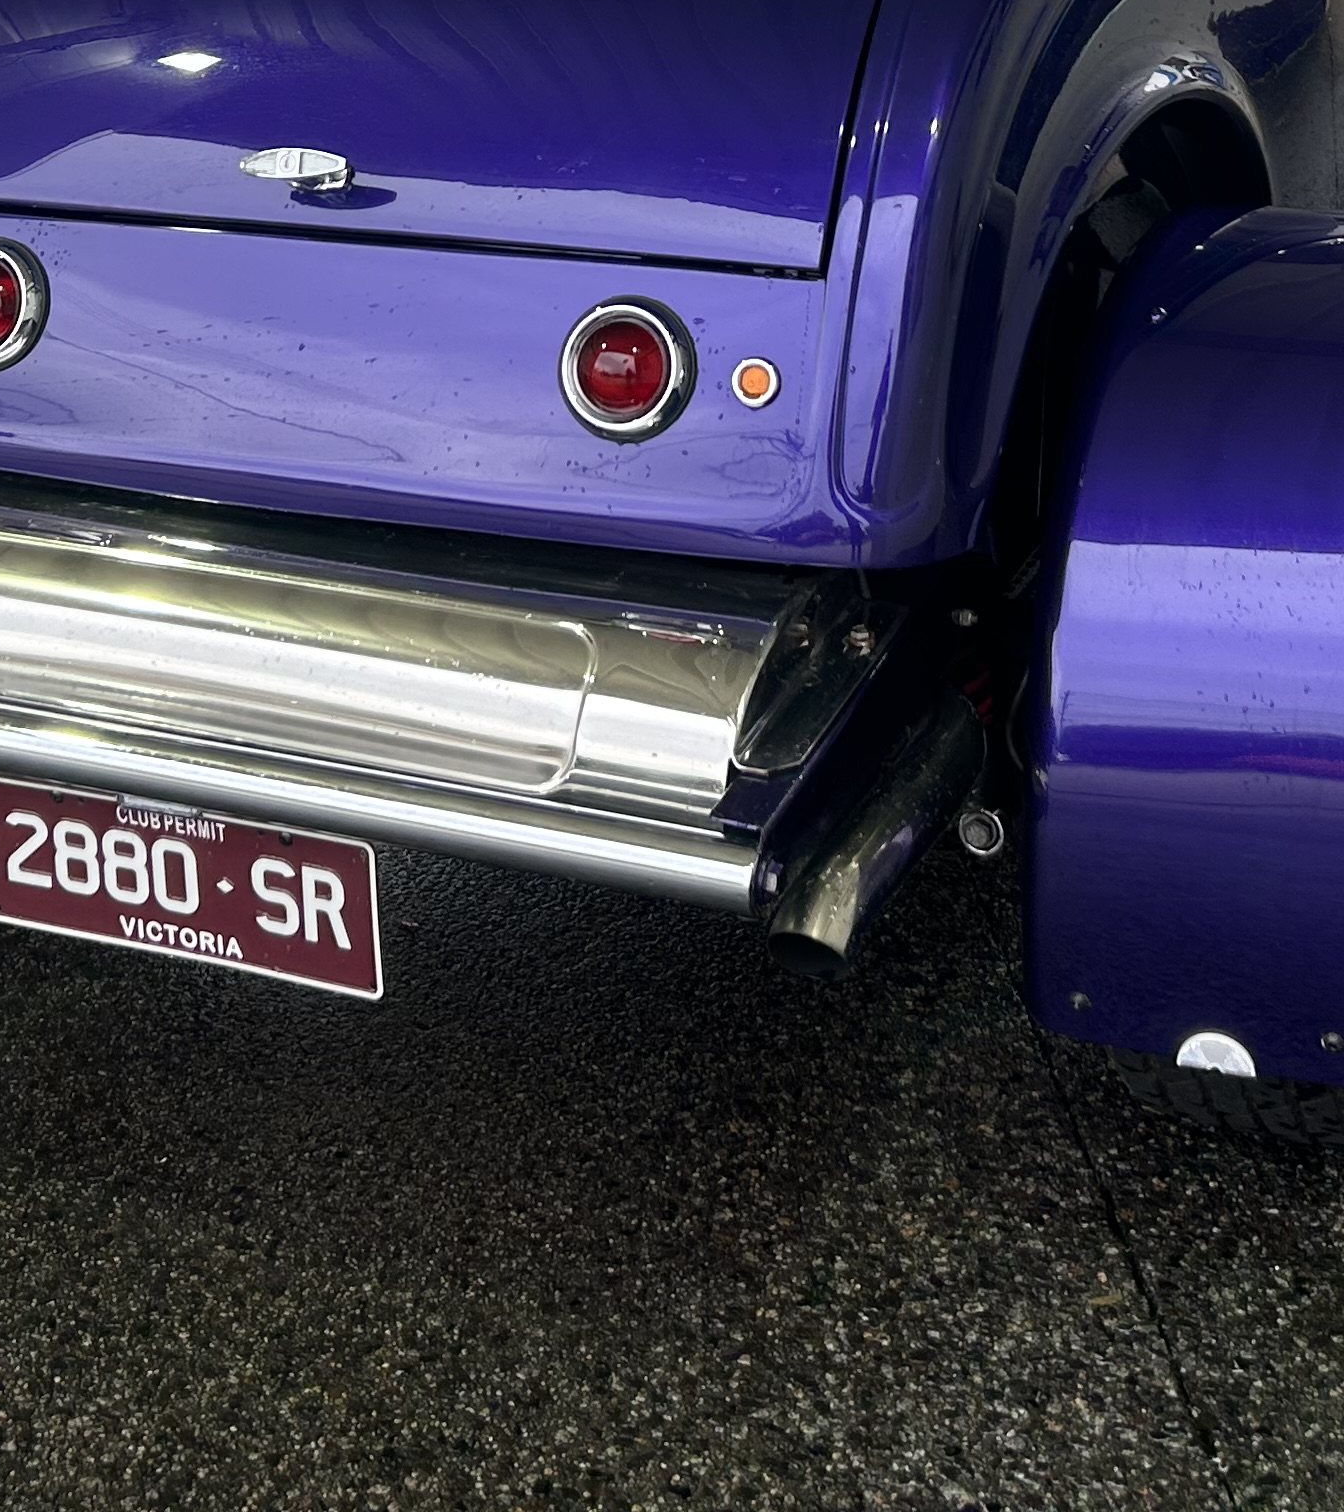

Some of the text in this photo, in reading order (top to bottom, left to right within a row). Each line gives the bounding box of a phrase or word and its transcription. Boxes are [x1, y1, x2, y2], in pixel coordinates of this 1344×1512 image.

[116, 805, 226, 843] CLUB PERMIT
[4, 810, 353, 951] 2880 SR
[119, 914, 244, 960] VICTORIA
